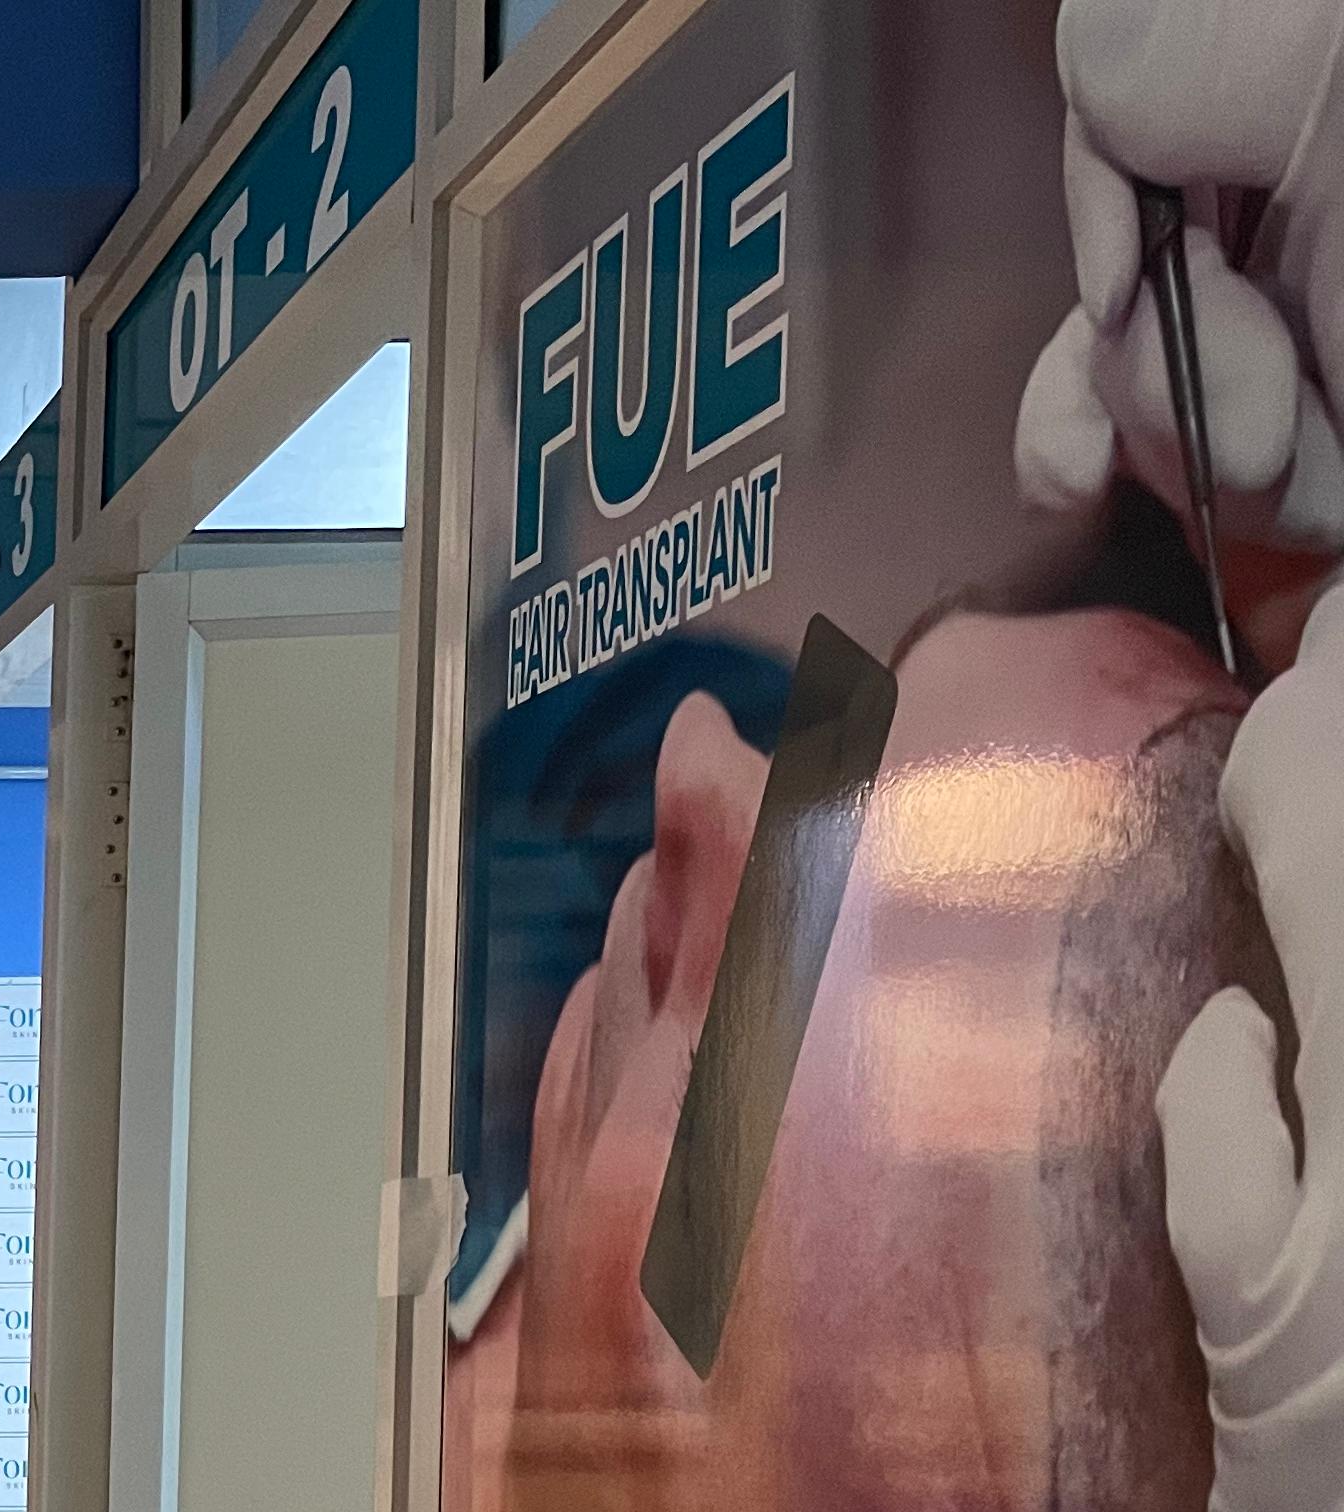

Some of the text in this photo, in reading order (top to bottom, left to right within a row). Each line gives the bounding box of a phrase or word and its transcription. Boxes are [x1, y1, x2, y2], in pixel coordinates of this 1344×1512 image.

[169, 187, 249, 413] OT
[306, 65, 352, 272] 2
[511, 71, 795, 580] FUE
[12, 452, 35, 577] 3
[507, 454, 782, 710] HAIR TRANSPLANT
